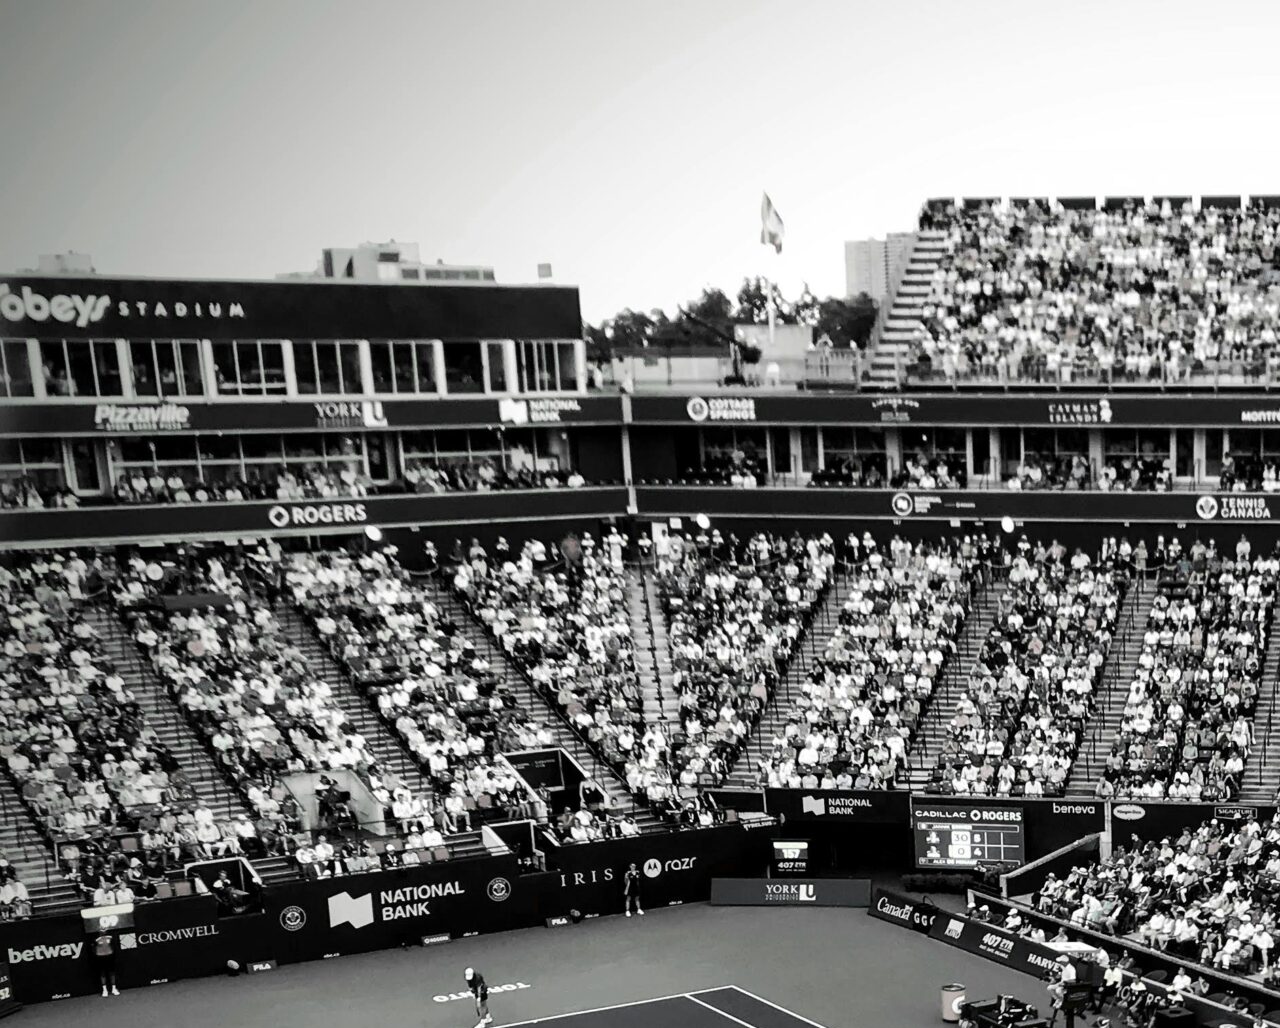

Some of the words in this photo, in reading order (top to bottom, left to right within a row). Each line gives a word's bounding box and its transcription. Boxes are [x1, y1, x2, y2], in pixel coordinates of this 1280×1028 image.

[118, 301, 245, 318] STADIUM
[315, 404, 361, 418] YORK
[531, 401, 580, 411] NATIONAL
[1049, 404, 1098, 413] CAYMAN
[531, 411, 561, 421] BANK
[1049, 414, 1098, 423] ISLANDS
[1221, 498, 1266, 508] TENNIS
[291, 504, 367, 524] ROGERS
[1220, 507, 1271, 518] CANADA
[828, 798, 873, 807] NATIONAL
[1053, 802, 1096, 814] beneva
[829, 807, 854, 815] BANK
[915, 810, 967, 818] CADILLAC
[982, 811, 1022, 821] ROGERS
[955, 834, 969, 842] 30
[958, 847, 965, 856] 0
[973, 848, 982, 857] 4
[665, 857, 696, 872] razr
[560, 868, 613, 887] IRIS
[380, 881, 465, 905] NATIONAL
[767, 885, 799, 893] YORK
[382, 902, 430, 921] BANK
[877, 897, 911, 921] Canada
[913, 912, 920, 924] G
[138, 924, 219, 945] CROMWELL
[982, 932, 1002, 948] 407
[8, 942, 83, 964] betway
[252, 963, 272, 971] FILA
[1027, 953, 1066, 974] HARVE
[432, 982, 531, 1002] TORNTO
